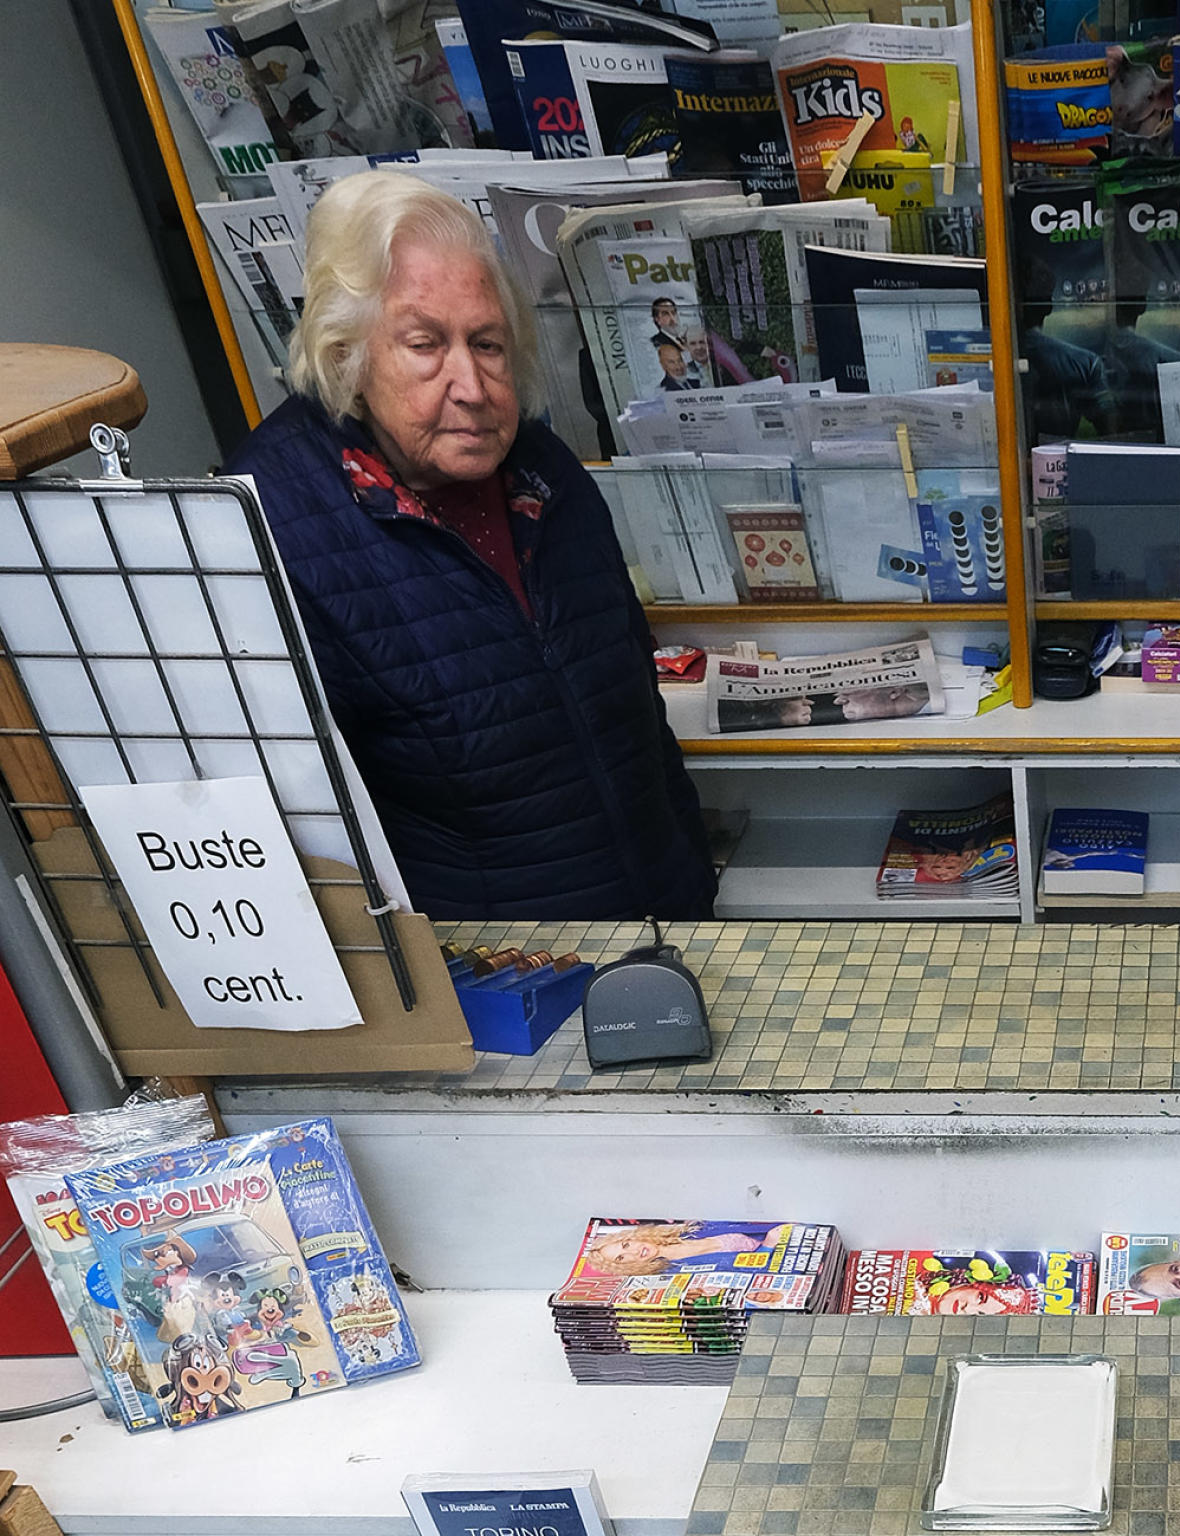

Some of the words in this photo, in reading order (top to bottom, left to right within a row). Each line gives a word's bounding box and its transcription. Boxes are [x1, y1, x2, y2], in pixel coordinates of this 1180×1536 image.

[578, 52, 657, 72] LUOGHI
[792, 78, 882, 123] Kids
[759, 142, 776, 153] Gli
[740, 153, 769, 164] Stati
[854, 174, 894, 189] UHU
[763, 665, 779, 676] la
[781, 656, 877, 676] Repubblica
[726, 681, 836, 696] L'America
[837, 669, 917, 690] contesa
[136, 829, 267, 872] Buste
[169, 898, 265, 946] 0,10
[203, 966, 303, 1003] cent.
[593, 1021, 637, 1034] DATALOGIC
[90, 1175, 272, 1235] TOPOLINO
[526, 1502, 569, 1511] STAMPA
